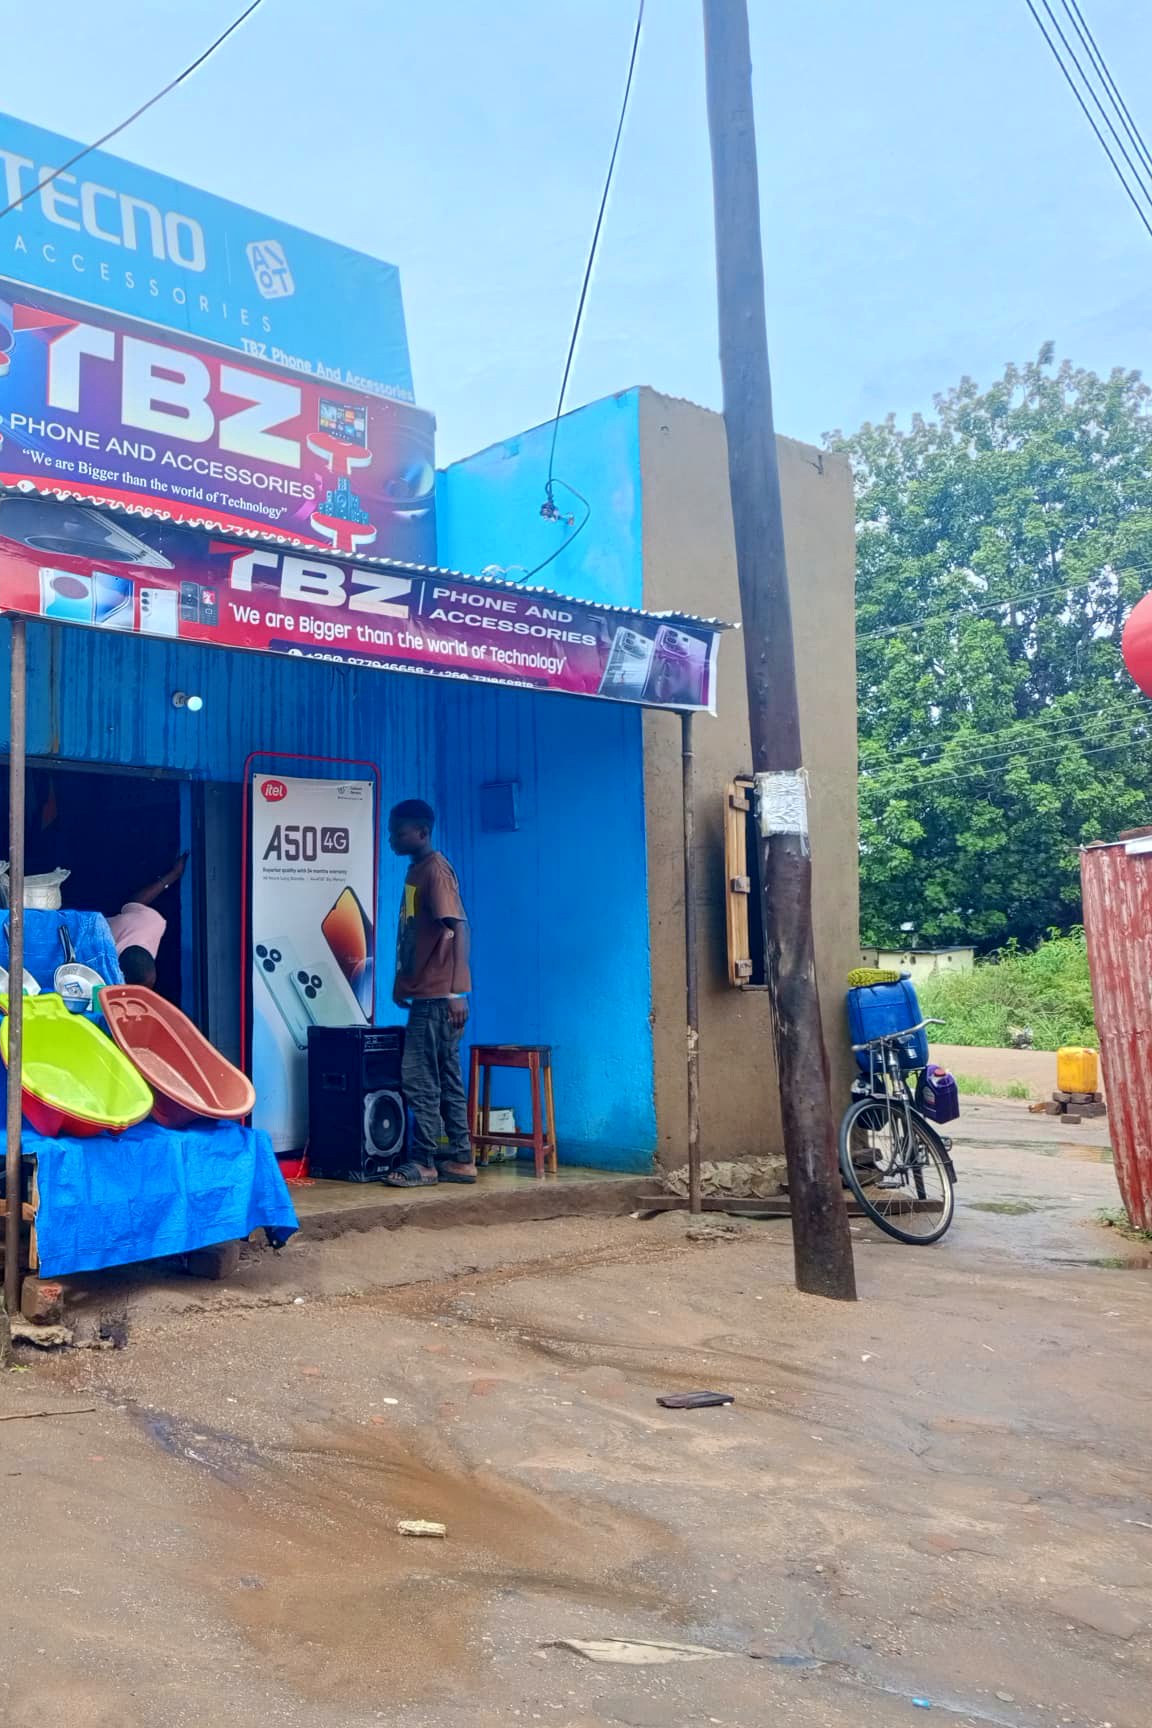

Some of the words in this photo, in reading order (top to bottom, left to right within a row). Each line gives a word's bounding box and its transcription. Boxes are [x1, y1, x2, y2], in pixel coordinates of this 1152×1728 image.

[14, 235, 273, 333] ACCESSORIES
[241, 337, 268, 359] TBZ
[271, 346, 313, 374] Phone
[316, 361, 342, 383] And
[14, 304, 303, 469] TBZ
[10, 413, 100, 450] PHONE
[105, 437, 156, 462] AND
[160, 451, 316, 500] ACCESSORIES
[55, 458, 75, 472] are
[78, 461, 120, 482] Bigger
[122, 471, 147, 488] than
[150, 478, 168, 492] the
[171, 485, 203, 500] world
[206, 491, 219, 503] of
[209, 541, 413, 619] TBZ
[429, 608, 597, 646] ACCESSORIES
[432, 586, 518, 614] PHONE
[525, 605, 573, 623] AND
[265, 612, 294, 630] are
[299, 616, 352, 641] Bigger
[356, 626, 393, 646] than
[397, 632, 424, 650] the
[427, 637, 468, 657] world
[472, 644, 487, 659] of
[265, 784, 284, 797] itel
[262, 825, 317, 861] A50
[323, 831, 347, 849] 4G
